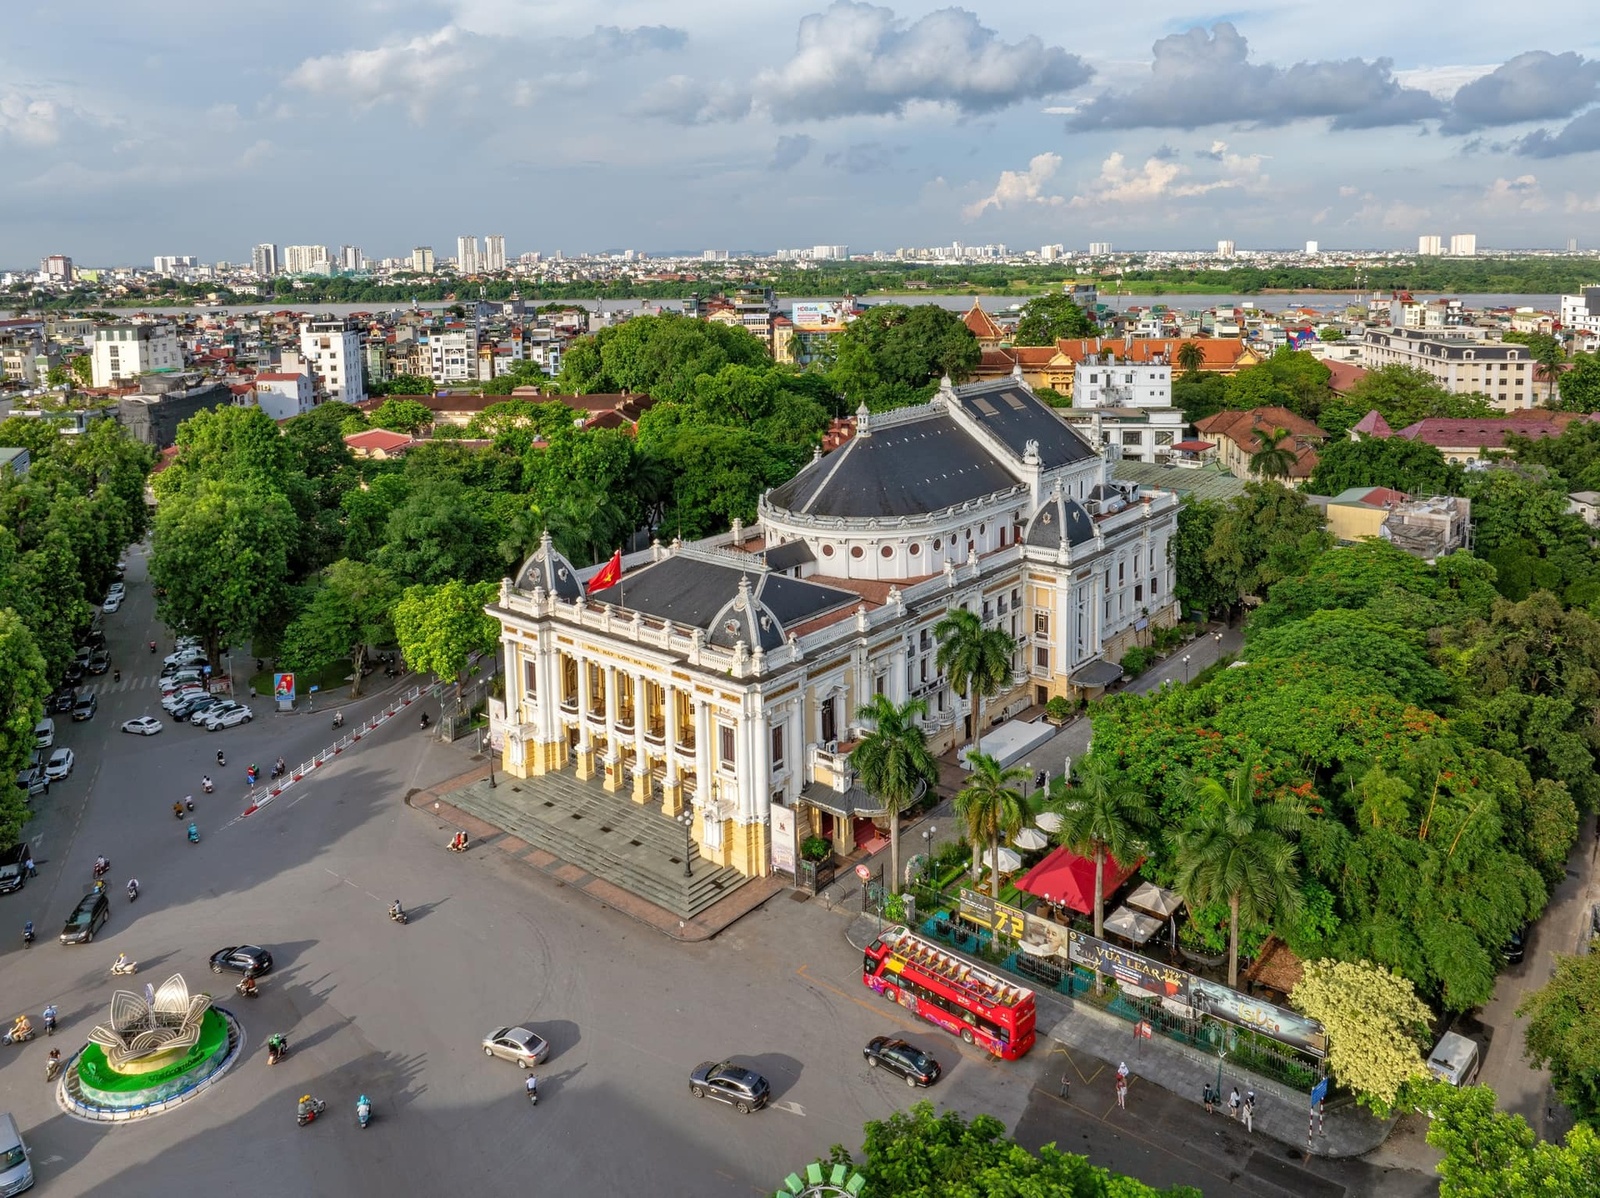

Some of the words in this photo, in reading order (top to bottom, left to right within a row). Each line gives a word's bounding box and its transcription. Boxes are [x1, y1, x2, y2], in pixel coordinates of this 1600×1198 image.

[994, 910, 1024, 939] 72
[1095, 946, 1123, 965] VUA
[1127, 959, 1163, 982] LEAR
